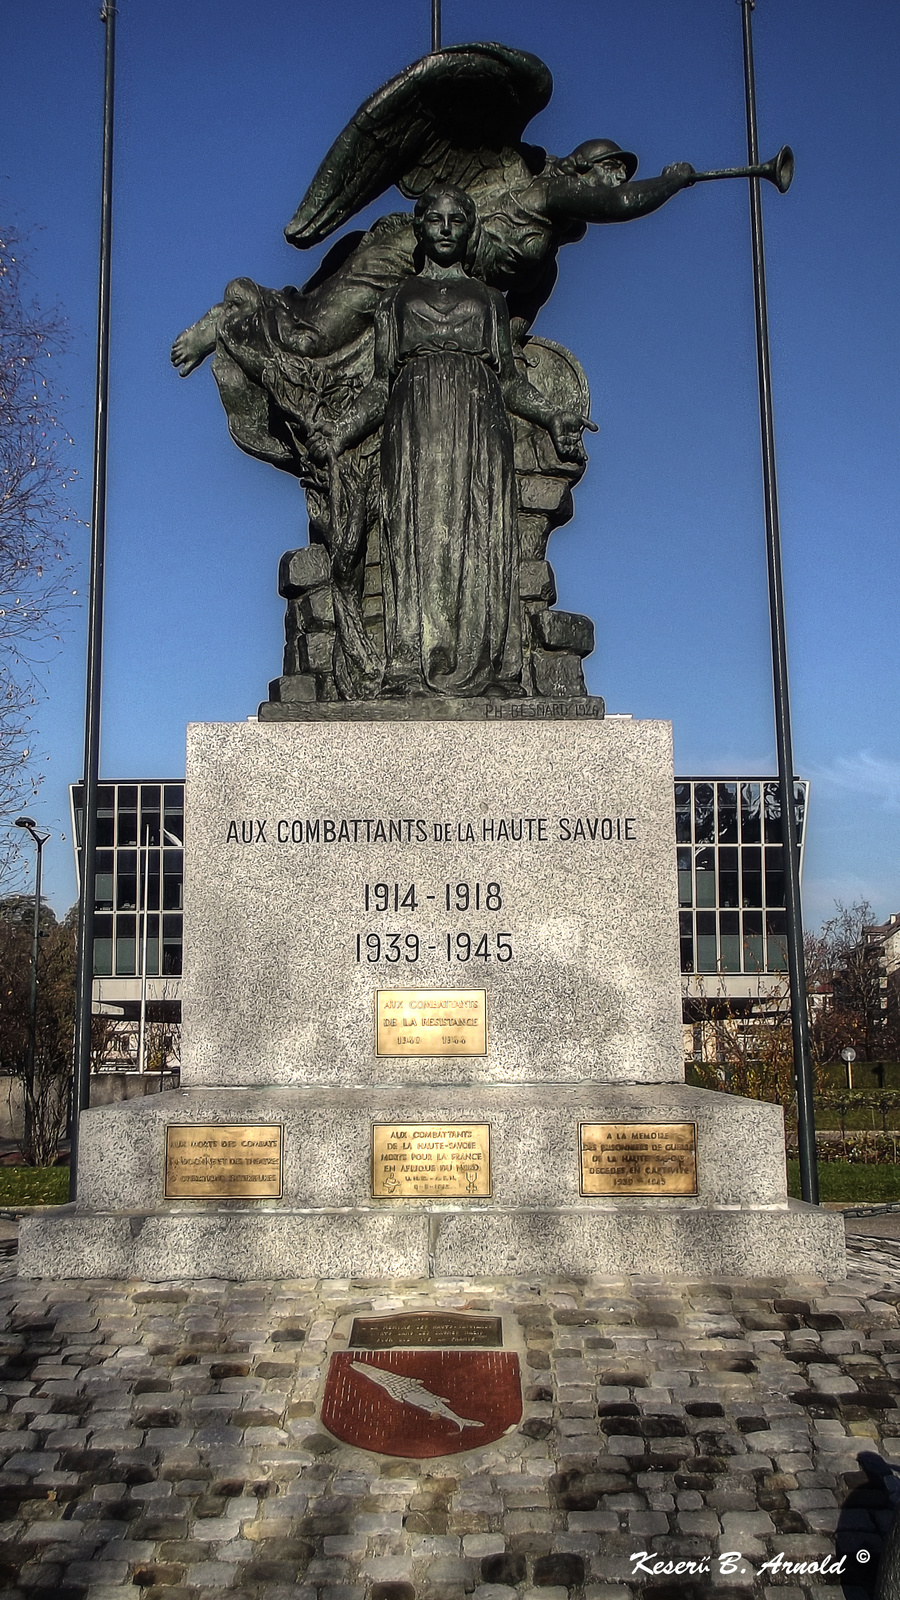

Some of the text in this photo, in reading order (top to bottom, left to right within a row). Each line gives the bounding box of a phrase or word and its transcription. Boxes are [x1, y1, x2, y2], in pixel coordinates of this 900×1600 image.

[511, 702, 568, 718] BESNARD
[226, 817, 636, 844] AUX COMBATTANTS DE LA HAUTE SAVOIE
[364, 882, 419, 912] 1914
[445, 881, 502, 912] 1918
[356, 932, 420, 963] 1939
[446, 931, 513, 963] 1945
[383, 1000, 479, 1010] AUX COMBATTANTS
[383, 1018, 479, 1027] DE LA RESISTANCE
[390, 1131, 407, 1139] AUX
[631, 1132, 669, 1140] MEMOIRE
